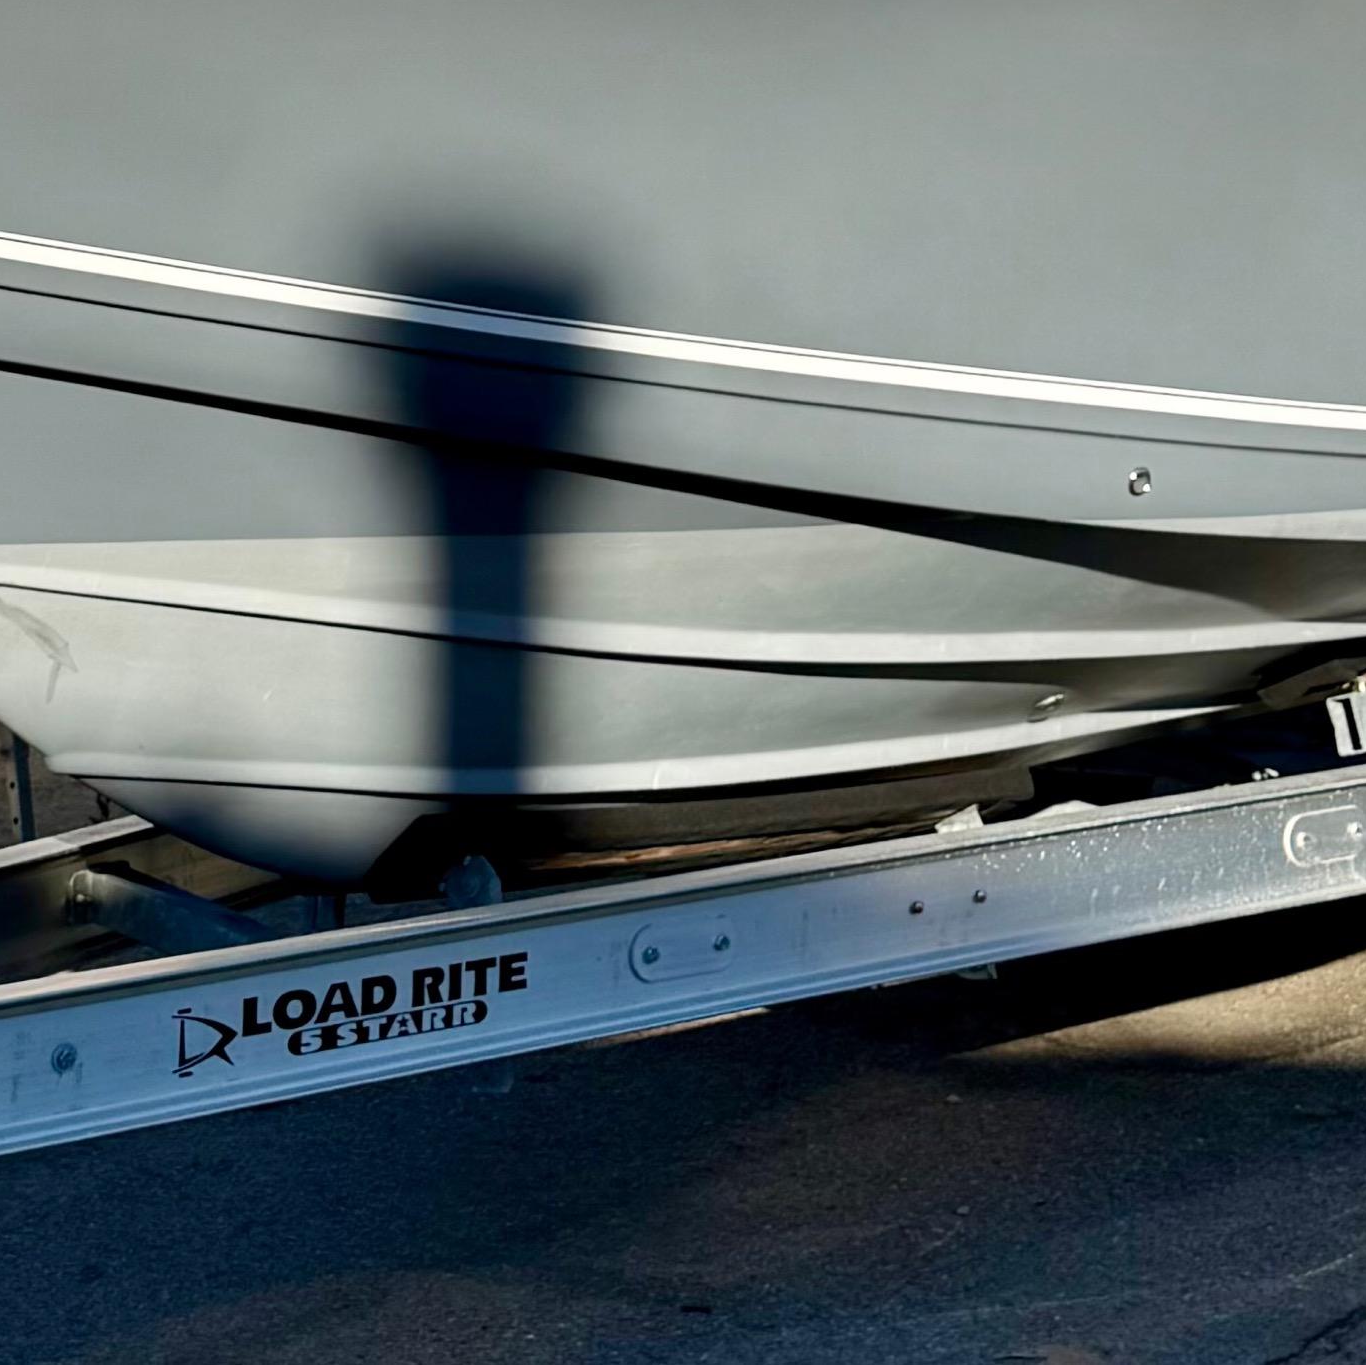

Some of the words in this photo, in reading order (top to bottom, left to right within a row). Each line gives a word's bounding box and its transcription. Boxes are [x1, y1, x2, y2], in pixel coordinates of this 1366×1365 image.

[241, 974, 397, 1037] LOAD
[411, 951, 529, 1007] RITE
[300, 1029, 323, 1053] 5
[335, 1003, 479, 1050] STARR
